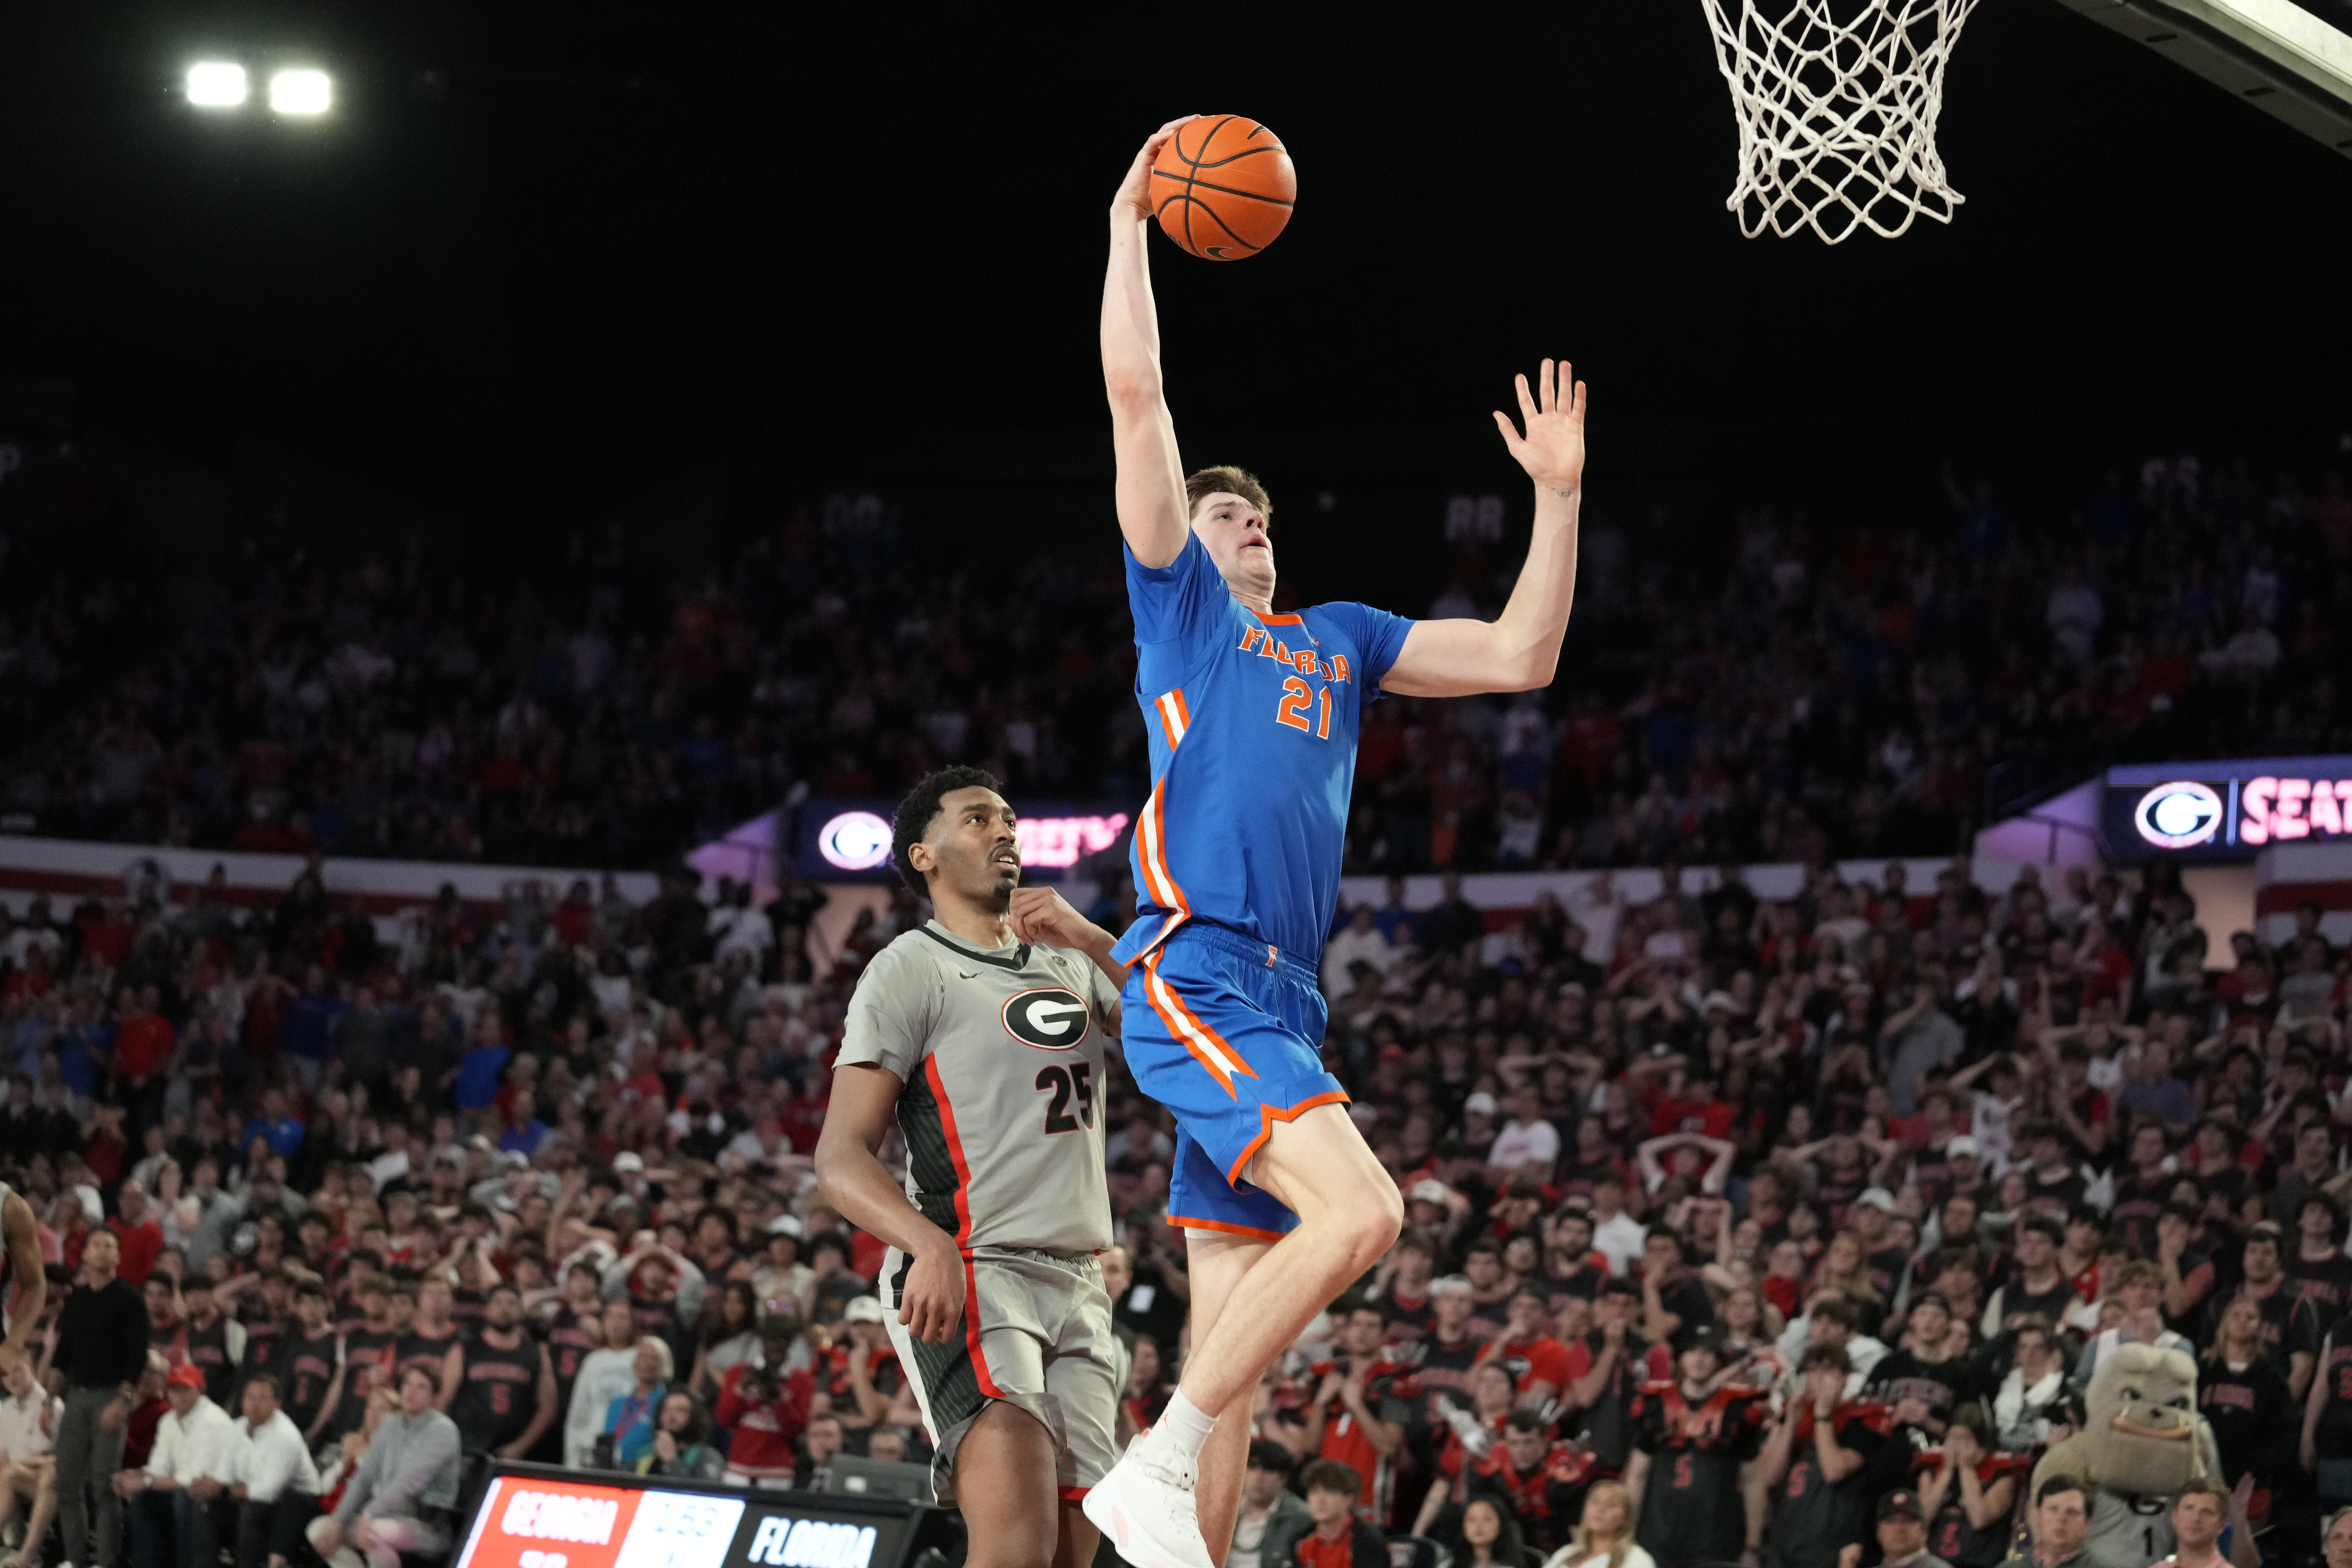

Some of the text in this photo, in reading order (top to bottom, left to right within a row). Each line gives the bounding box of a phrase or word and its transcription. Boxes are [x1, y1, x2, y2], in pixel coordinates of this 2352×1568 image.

[1237, 623, 1351, 685] FLORDA
[1276, 676, 1332, 740] 21
[1265, 945, 1278, 967] F
[1001, 987, 1090, 1051] G
[1035, 1062, 1094, 1135] 25
[1673, 1455, 1692, 1489] 5
[1787, 1463, 1810, 1498] 5
[747, 1516, 877, 1568] FLORIDA
[1939, 1523, 1960, 1557] 5
[2143, 1527, 2153, 1558] 1
